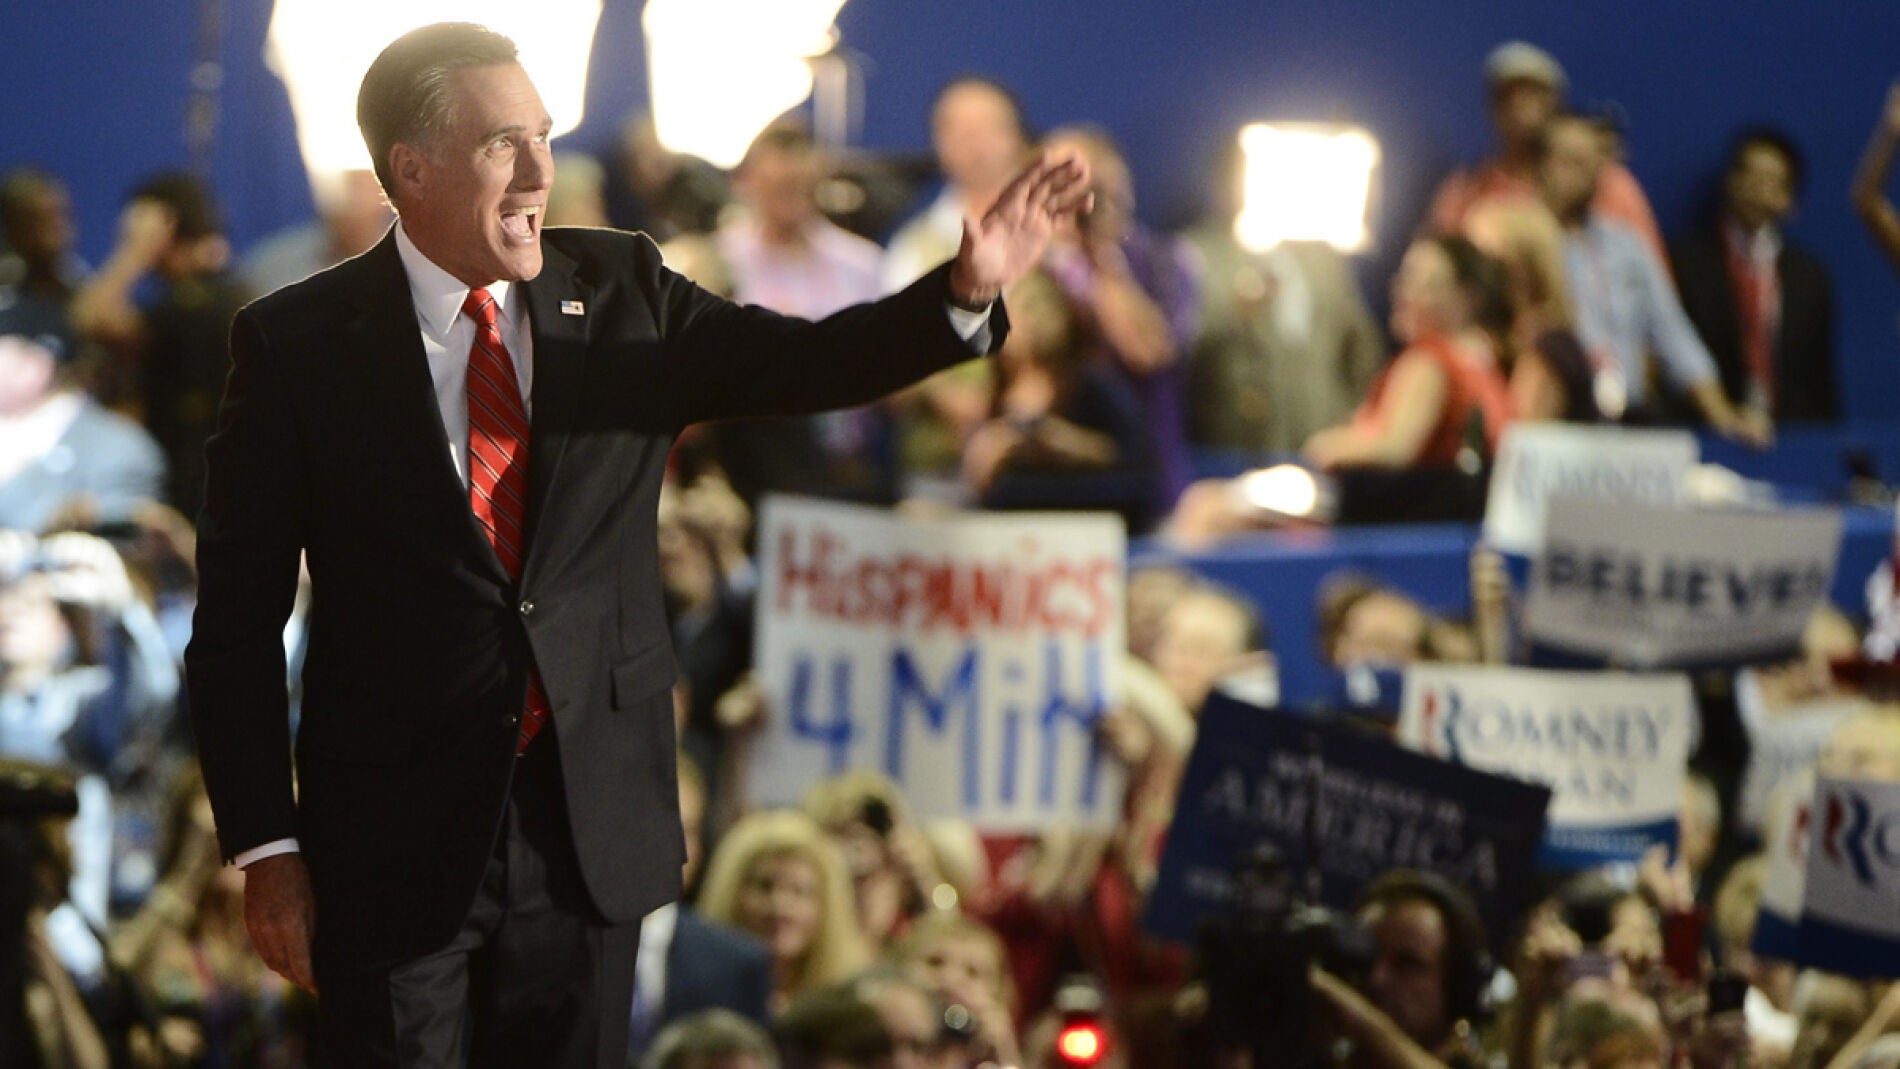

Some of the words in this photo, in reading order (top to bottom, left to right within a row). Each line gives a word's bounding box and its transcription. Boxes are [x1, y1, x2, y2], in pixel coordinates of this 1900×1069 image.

[788, 655, 852, 775] 4
[880, 636, 1108, 812] Mitt
[1420, 683, 1674, 763] ROMNEY
